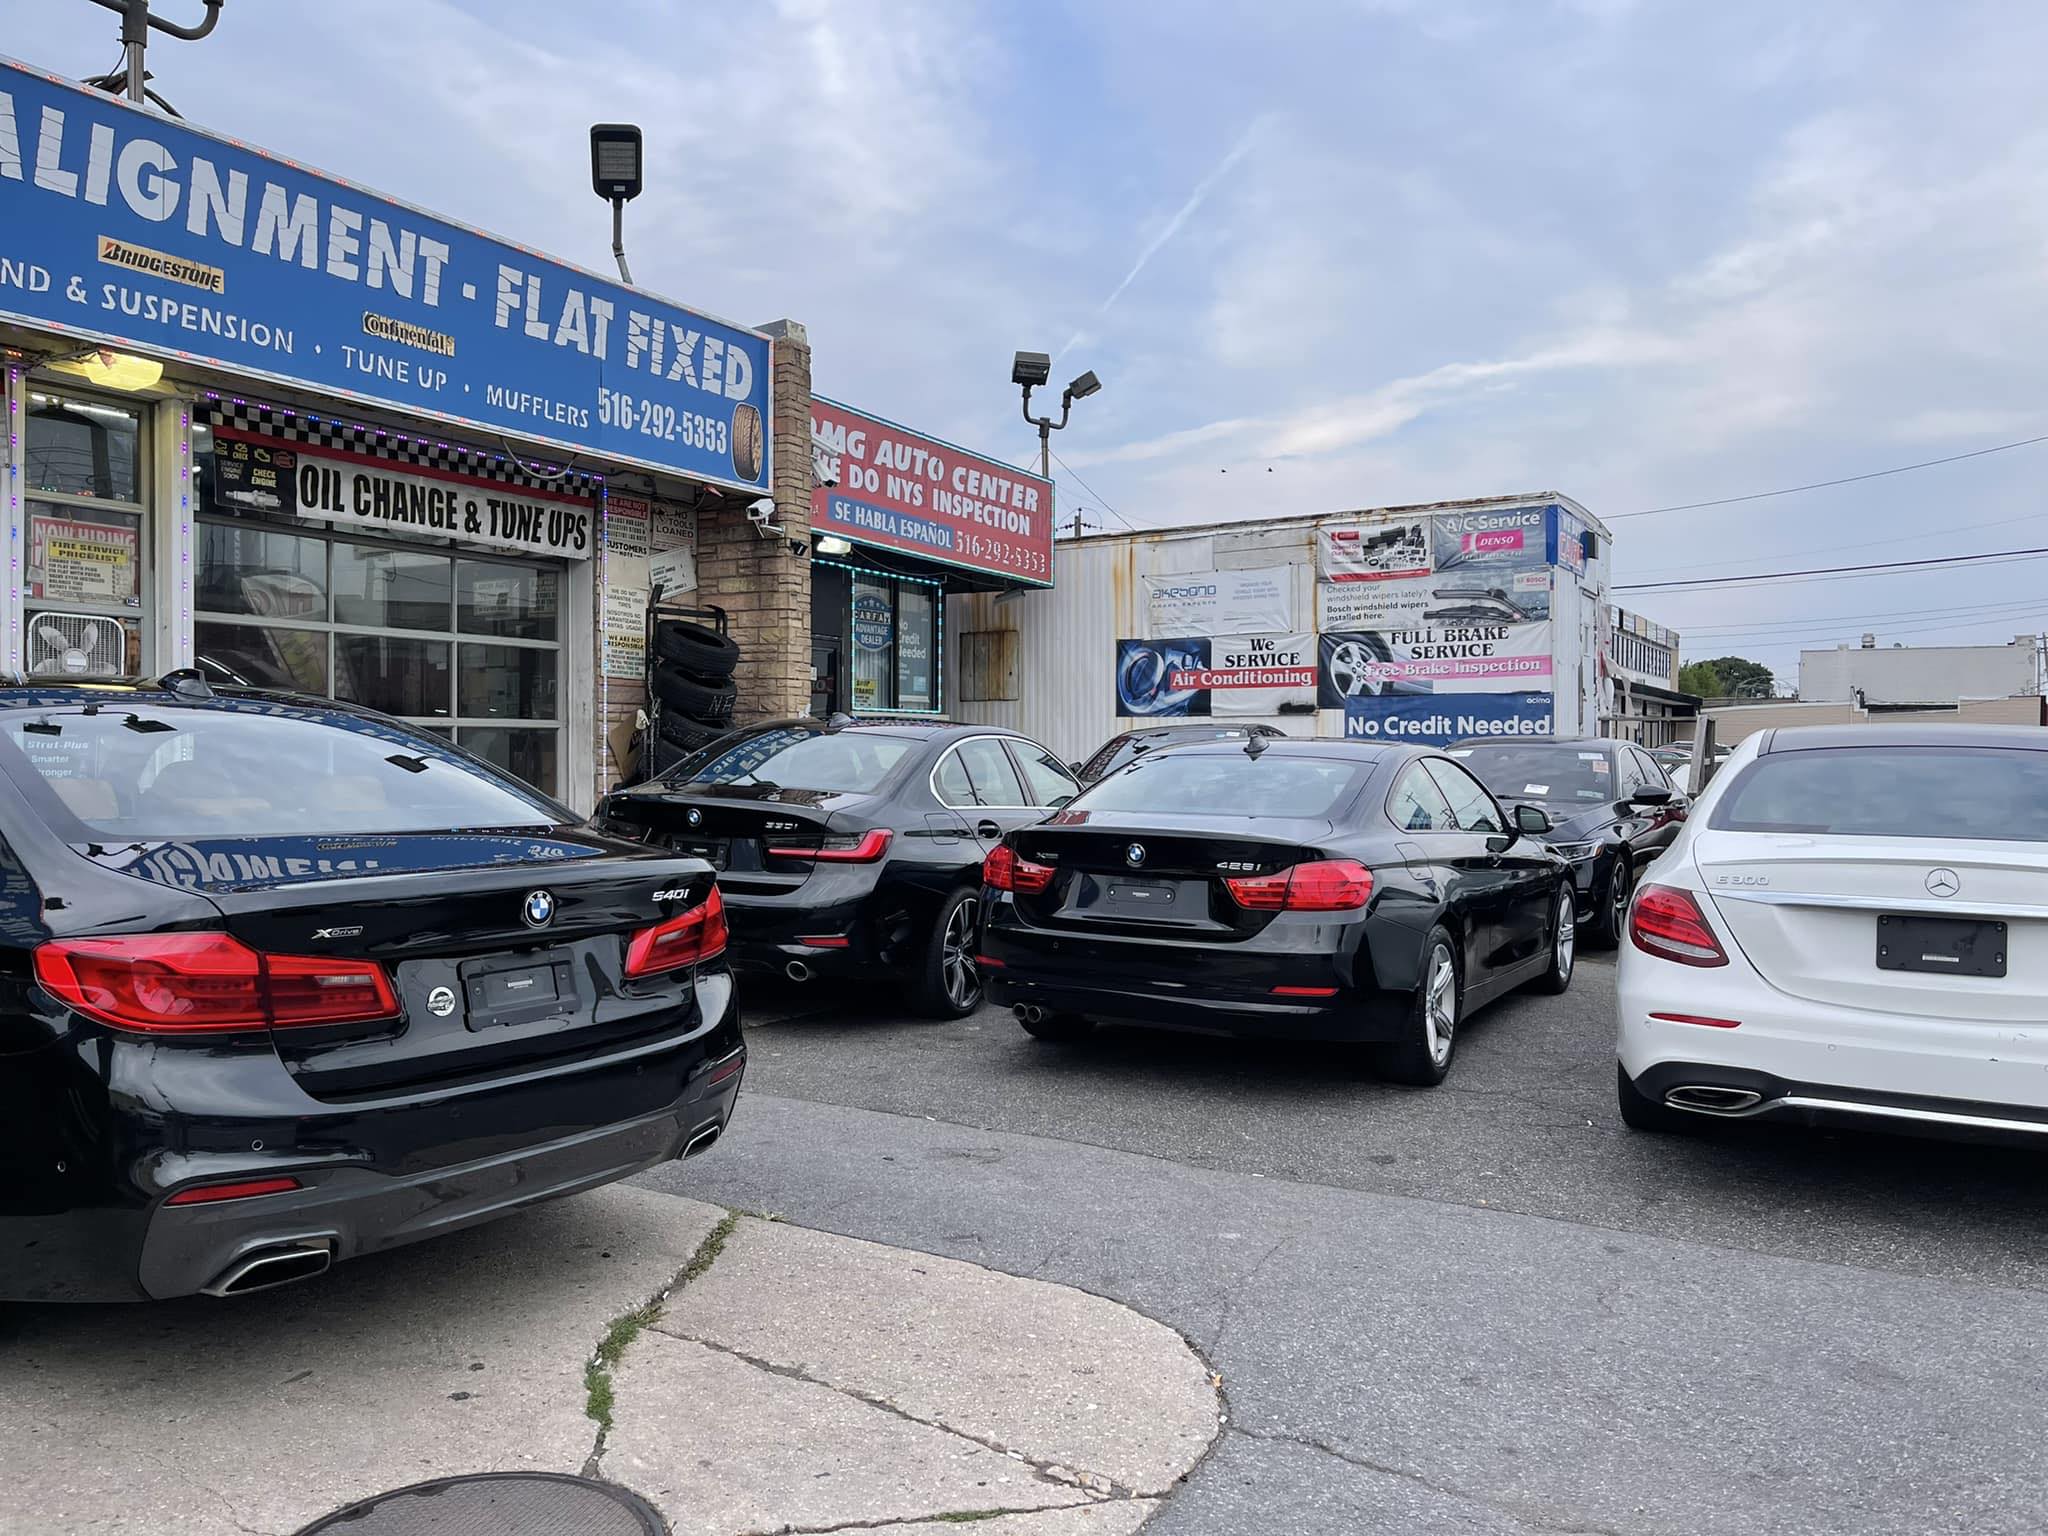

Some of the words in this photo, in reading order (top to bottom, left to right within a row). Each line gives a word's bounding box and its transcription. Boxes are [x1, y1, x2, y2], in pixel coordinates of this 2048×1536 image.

[102, 242, 222, 289] BRIDGESTONE
[495, 263, 614, 361] FLAT
[626, 310, 752, 402] FIXED
[1, 257, 51, 293] ND
[65, 276, 89, 305] &
[101, 284, 294, 353] SUSPENSION
[341, 345, 409, 384] TUNE
[418, 366, 447, 392] UP
[487, 384, 589, 429] MUFFLERS
[598, 386, 728, 454] 516-292-5353
[874, 440, 944, 482] AUTO
[952, 466, 1039, 512] CENTER
[300, 463, 345, 513] OIL
[353, 473, 458, 531] CHANGE
[464, 500, 483, 535] &
[487, 498, 545, 544] TUNE
[548, 509, 588, 551] UPS
[849, 464, 880, 493] DO
[886, 475, 923, 507] NYS
[932, 488, 1031, 537] INSPECTION
[675, 509, 688, 520] NO
[1446, 516, 1474, 532] A/C
[1478, 510, 1541, 530] Service
[656, 525, 694, 538] LOANED
[669, 518, 694, 530] TOOLS
[835, 501, 850, 521] SE
[855, 506, 897, 534] HABLA
[900, 518, 952, 549] ESPAÑOL
[51, 540, 78, 550] TIRE
[79, 544, 125, 556] SERVICE
[1480, 535, 1514, 546] DENSO
[1327, 585, 1361, 594] Checked
[1362, 584, 1381, 593] your
[1327, 593, 1372, 603] windshield
[1373, 592, 1399, 602] wipers
[1401, 589, 1428, 599] lately?
[1327, 604, 1352, 613] Bosch
[1354, 601, 1399, 612] windshield
[1400, 601, 1429, 610] wipers
[1327, 612, 1362, 622] installed
[1363, 611, 1385, 620] here.
[855, 623, 889, 636] ADVANTAGE
[1391, 630, 1437, 645] FULL
[1444, 626, 1510, 643] BRAKE
[861, 634, 883, 646] DEALER
[899, 632, 921, 645] redit
[1250, 638, 1275, 651] We
[1411, 643, 1494, 660] SERVICE
[1224, 652, 1301, 668] SERVICE
[1367, 662, 1401, 678] Free
[1404, 660, 1450, 676] Brake
[1455, 658, 1542, 676] Inspection
[1172, 673, 1197, 686] Air
[1201, 669, 1313, 687] Conditioning
[1348, 716, 1379, 735] No
[1384, 714, 1452, 735] Credit
[31, 754, 70, 764] Smarter
[39, 768, 73, 778] ronger
[1716, 876, 1730, 886] E
[1731, 875, 1770, 886] 300
